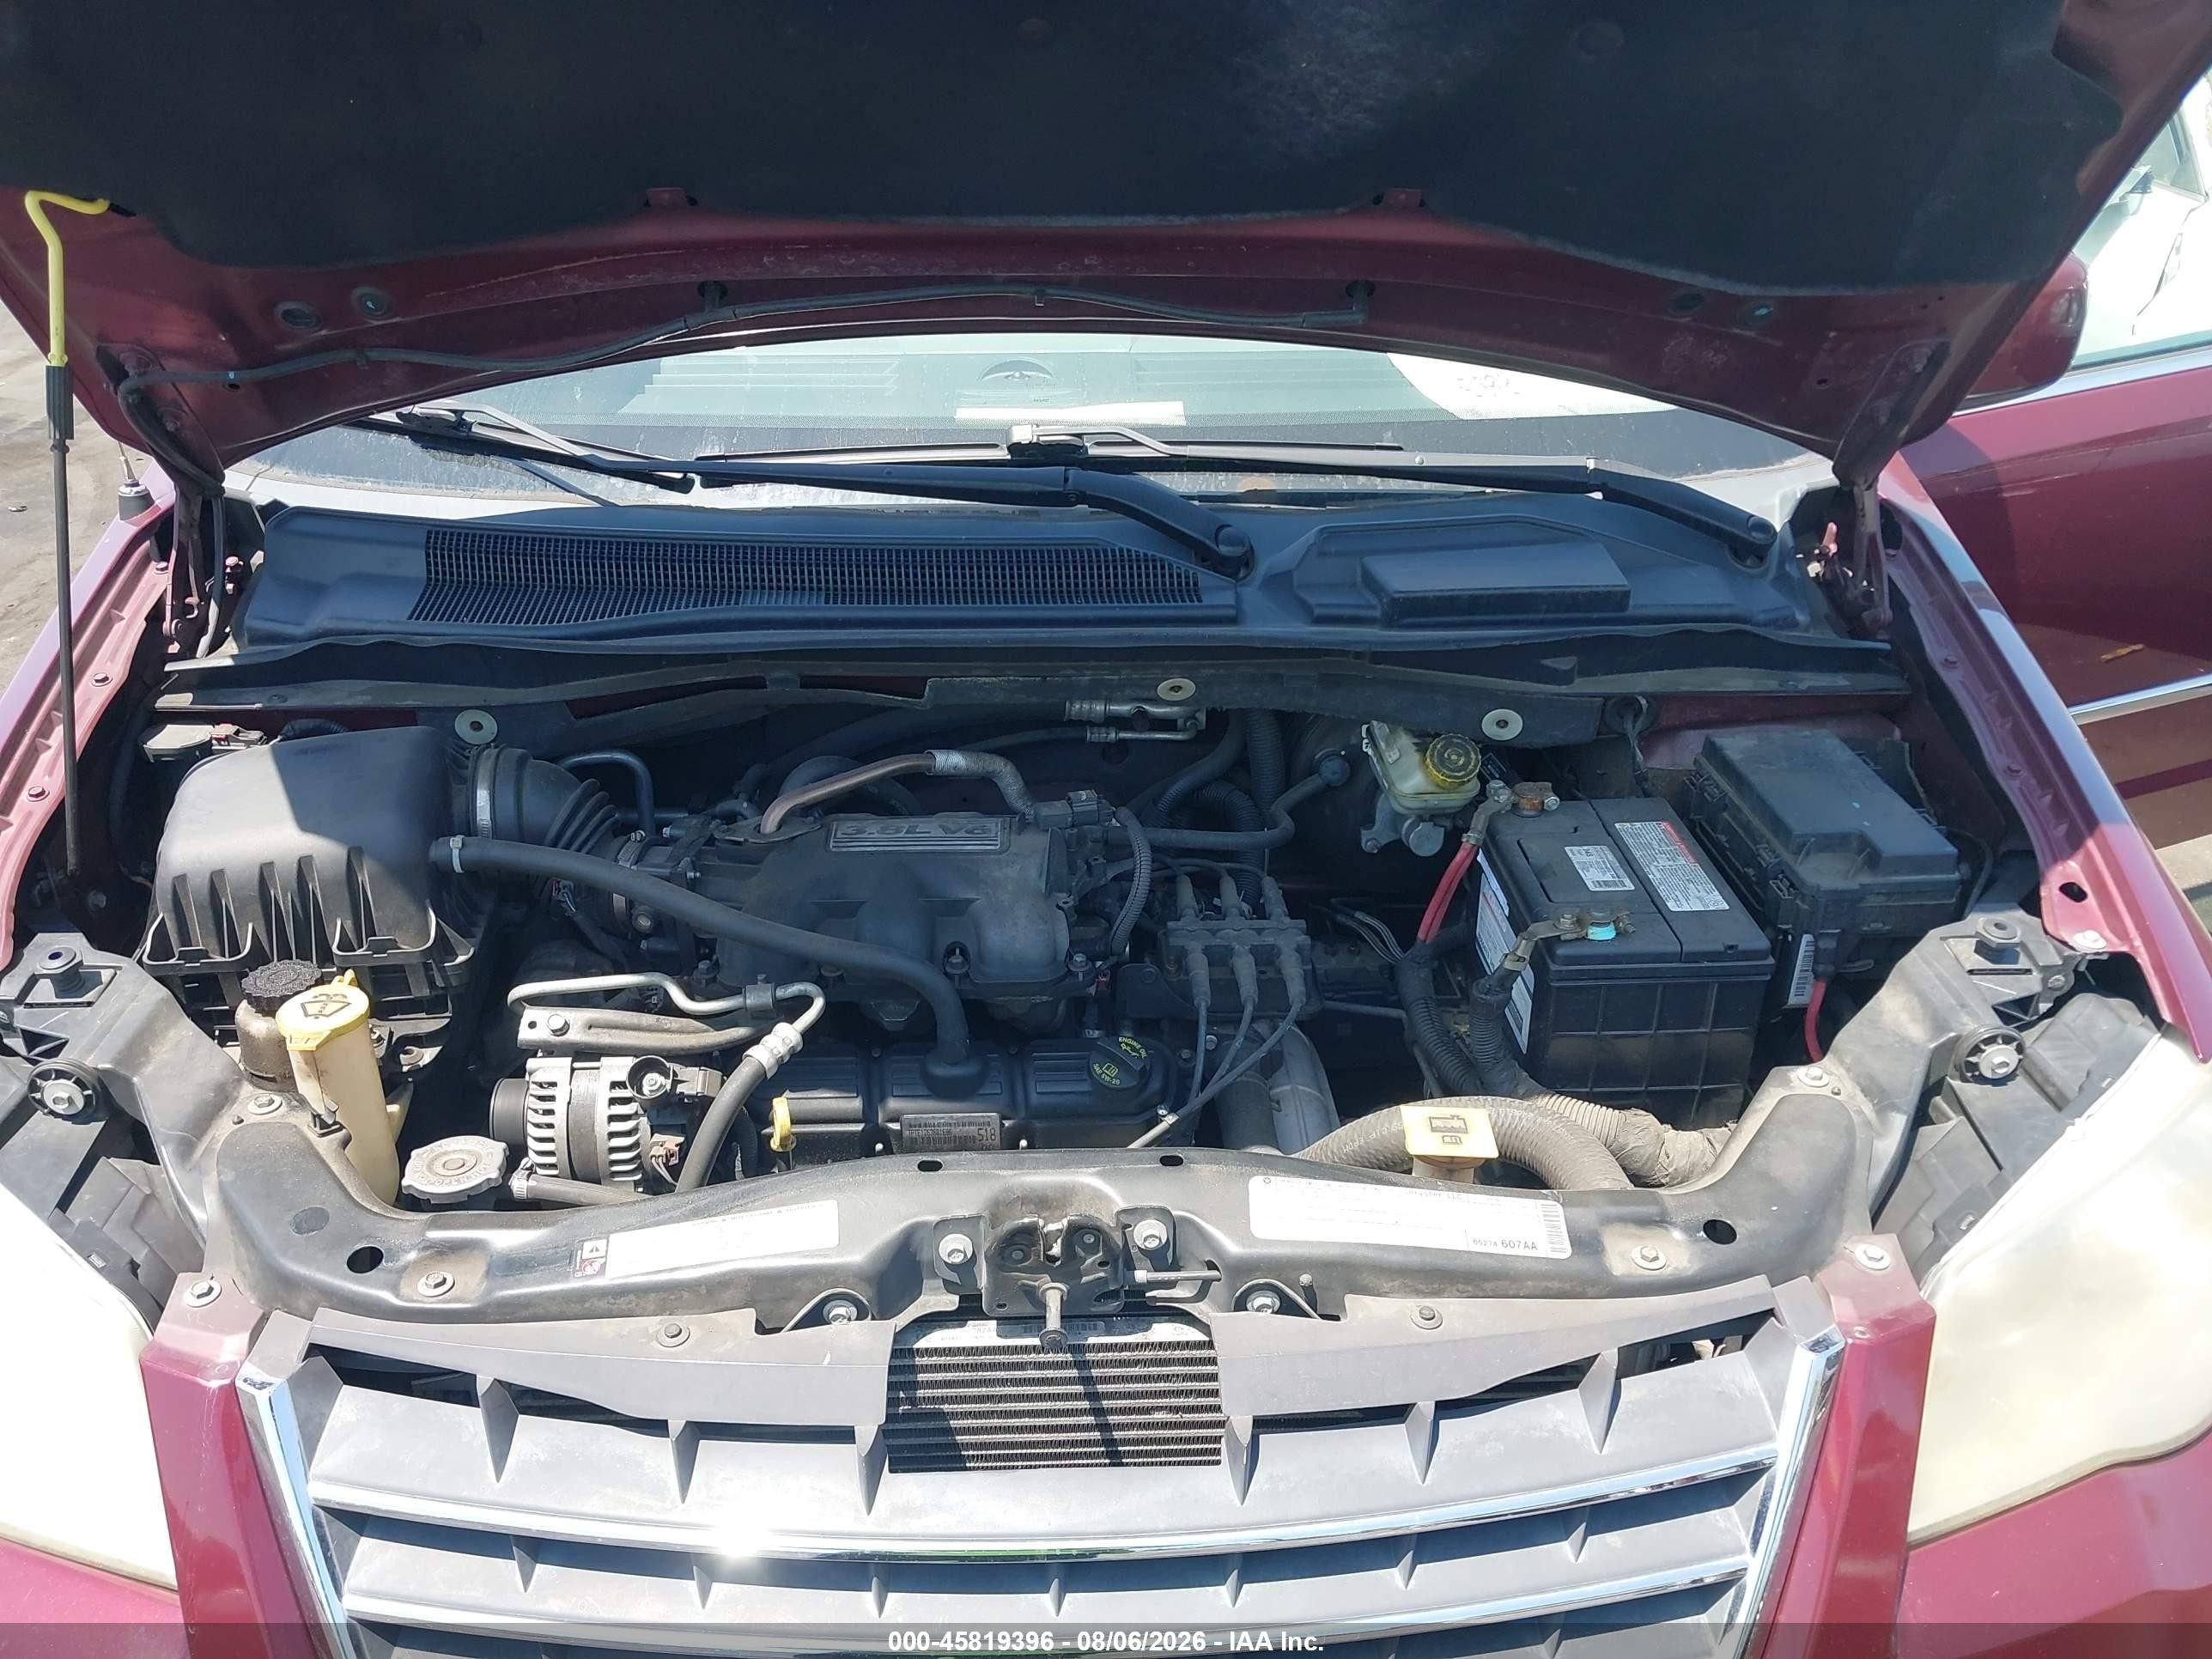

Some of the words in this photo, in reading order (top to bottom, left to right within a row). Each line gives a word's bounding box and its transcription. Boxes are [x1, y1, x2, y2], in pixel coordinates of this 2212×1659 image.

[841, 823, 931, 836] 3.8L
[939, 823, 993, 836] V6
[1118, 1036, 1142, 1050] ENGINE
[1139, 1048, 1147, 1058] OIL
[1101, 1073, 1121, 1085] 5W-20
[976, 1127, 996, 1142] 518
[1501, 1239, 1538, 1251] 607AA
